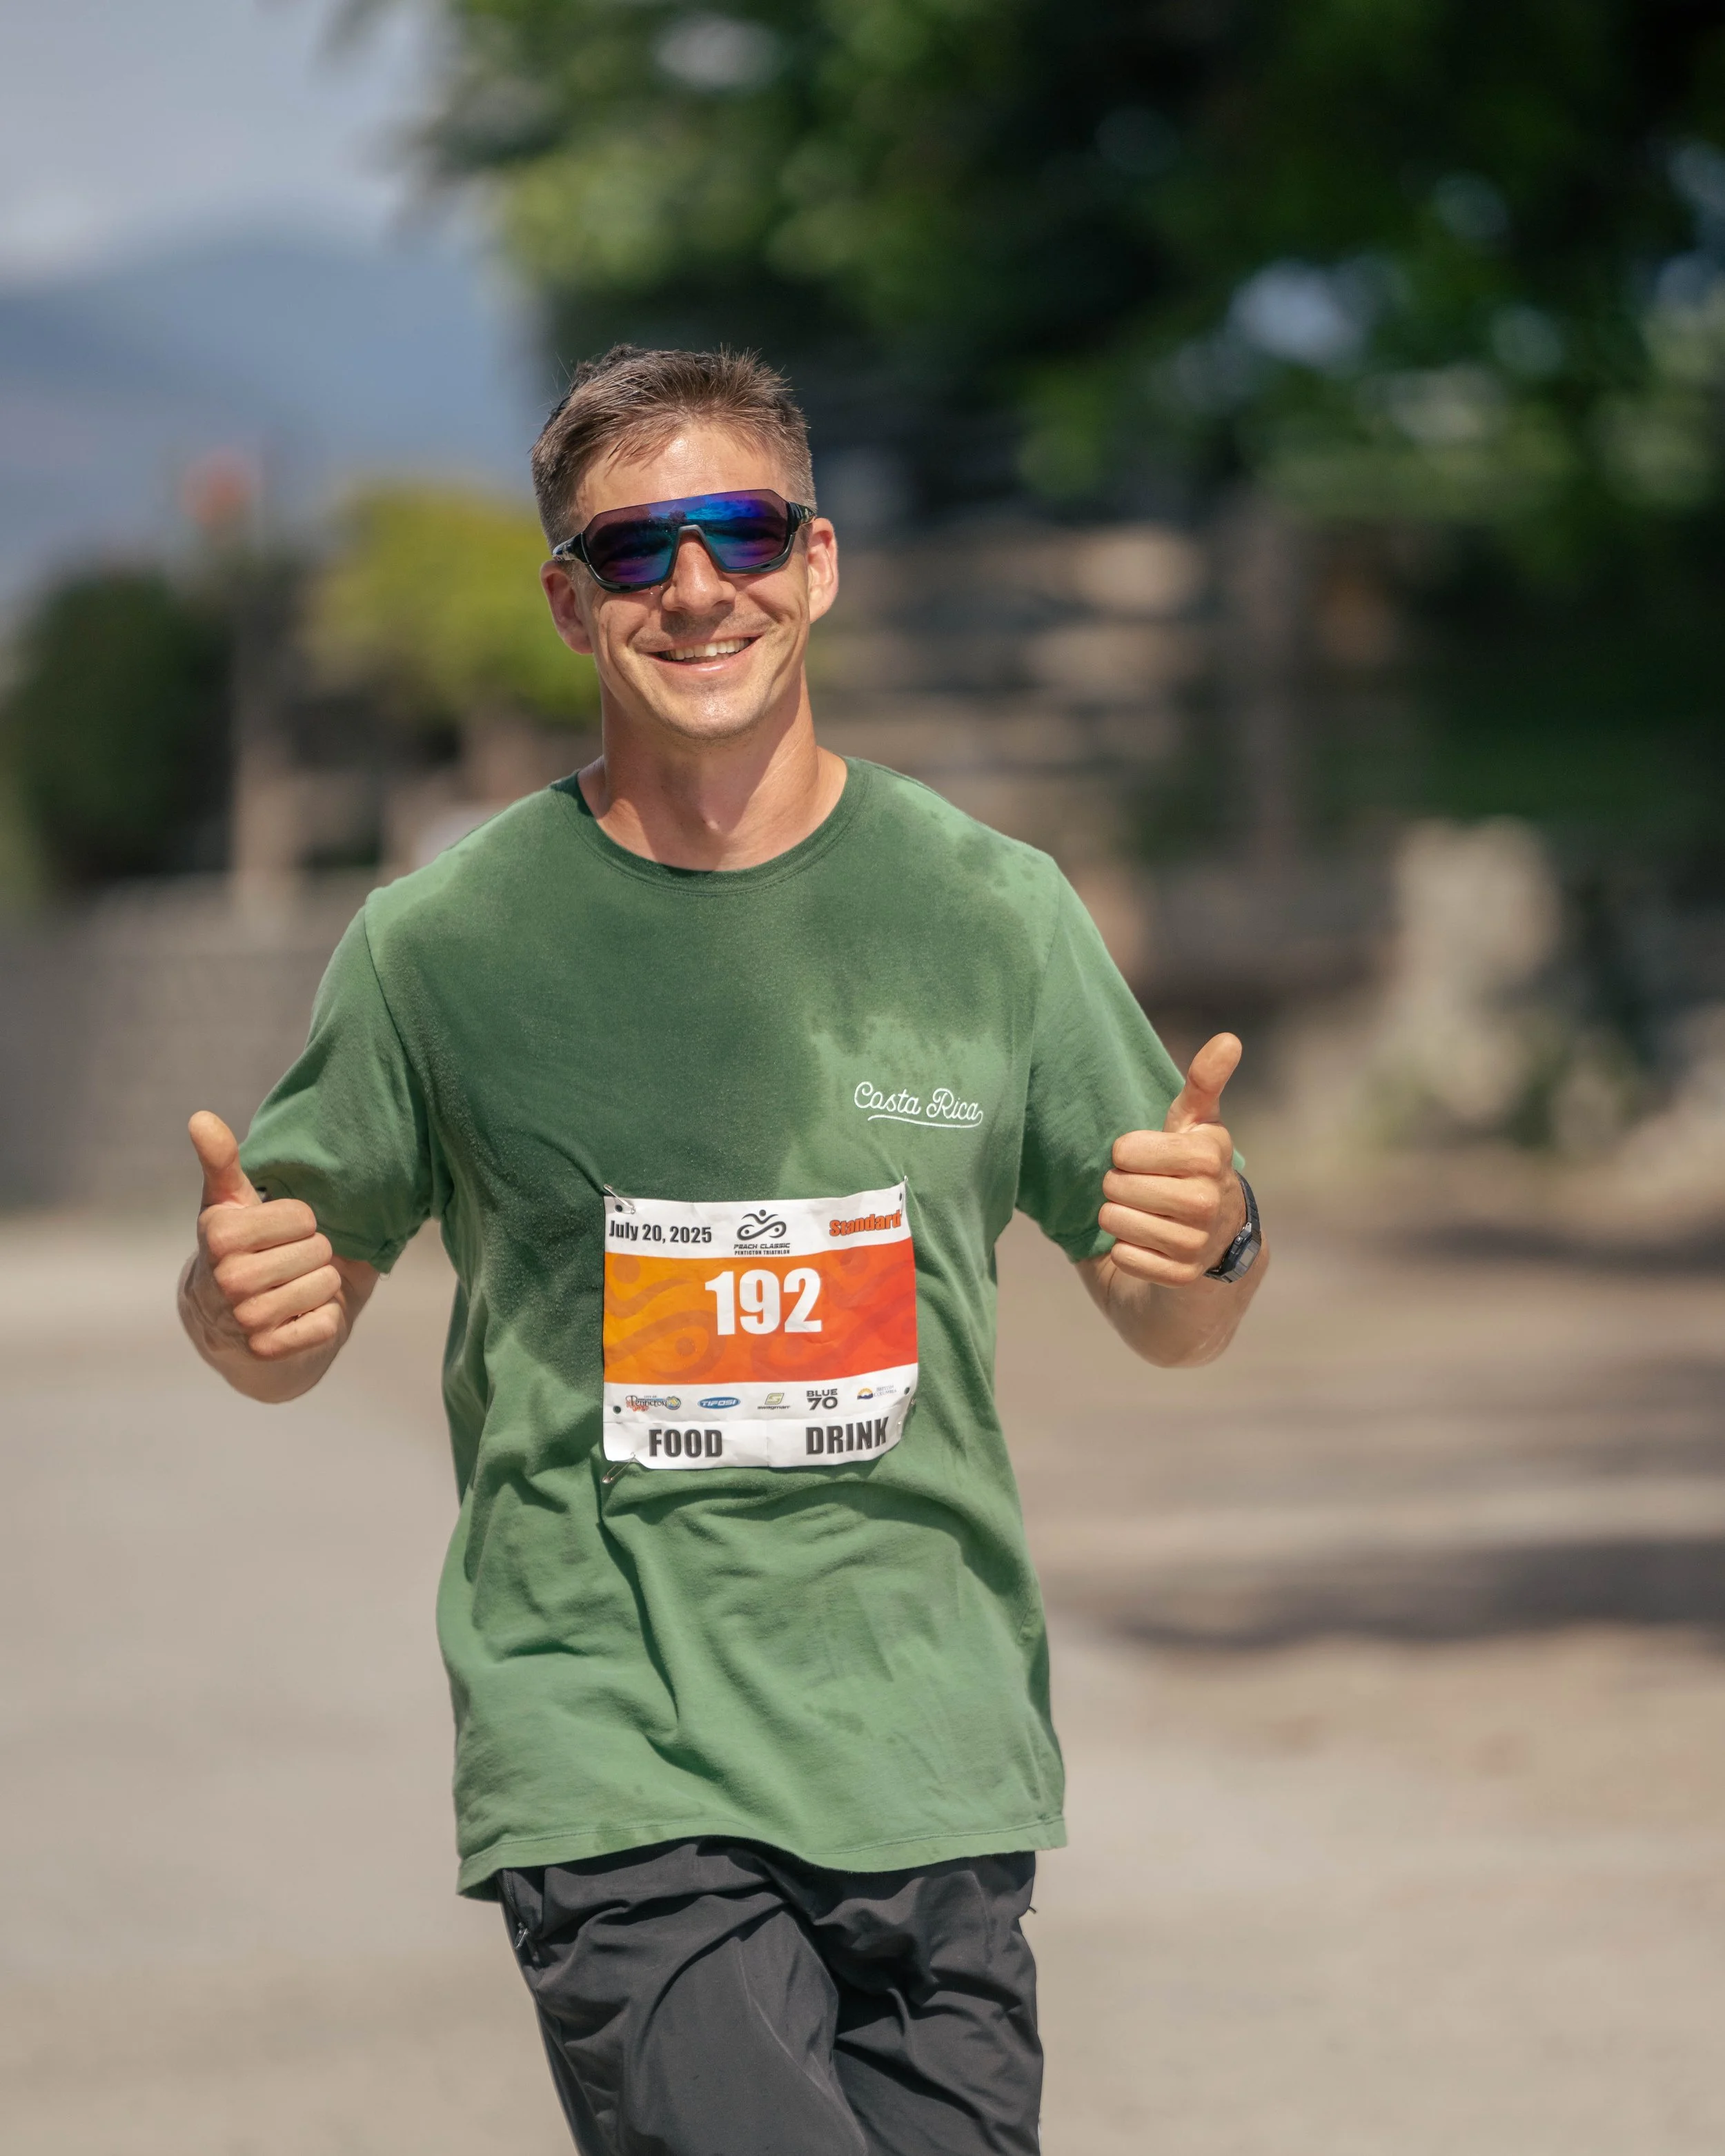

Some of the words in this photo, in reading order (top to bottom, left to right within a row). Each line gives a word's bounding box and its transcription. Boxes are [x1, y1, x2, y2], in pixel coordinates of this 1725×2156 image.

[854, 1081, 921, 1115] Costa
[926, 1087, 983, 1121] Rica
[609, 1220, 638, 1241] July
[642, 1223, 666, 1244] 20,
[669, 1225, 712, 1244] 2025
[829, 1209, 901, 1237] Standard
[704, 1267, 822, 1336] 192
[701, 1398, 736, 1407] TIFOSI
[806, 1388, 838, 1397] BLUE
[807, 1396, 838, 1411] 70
[649, 1428, 722, 1458] FOOD
[805, 1416, 889, 1456] DRINK
